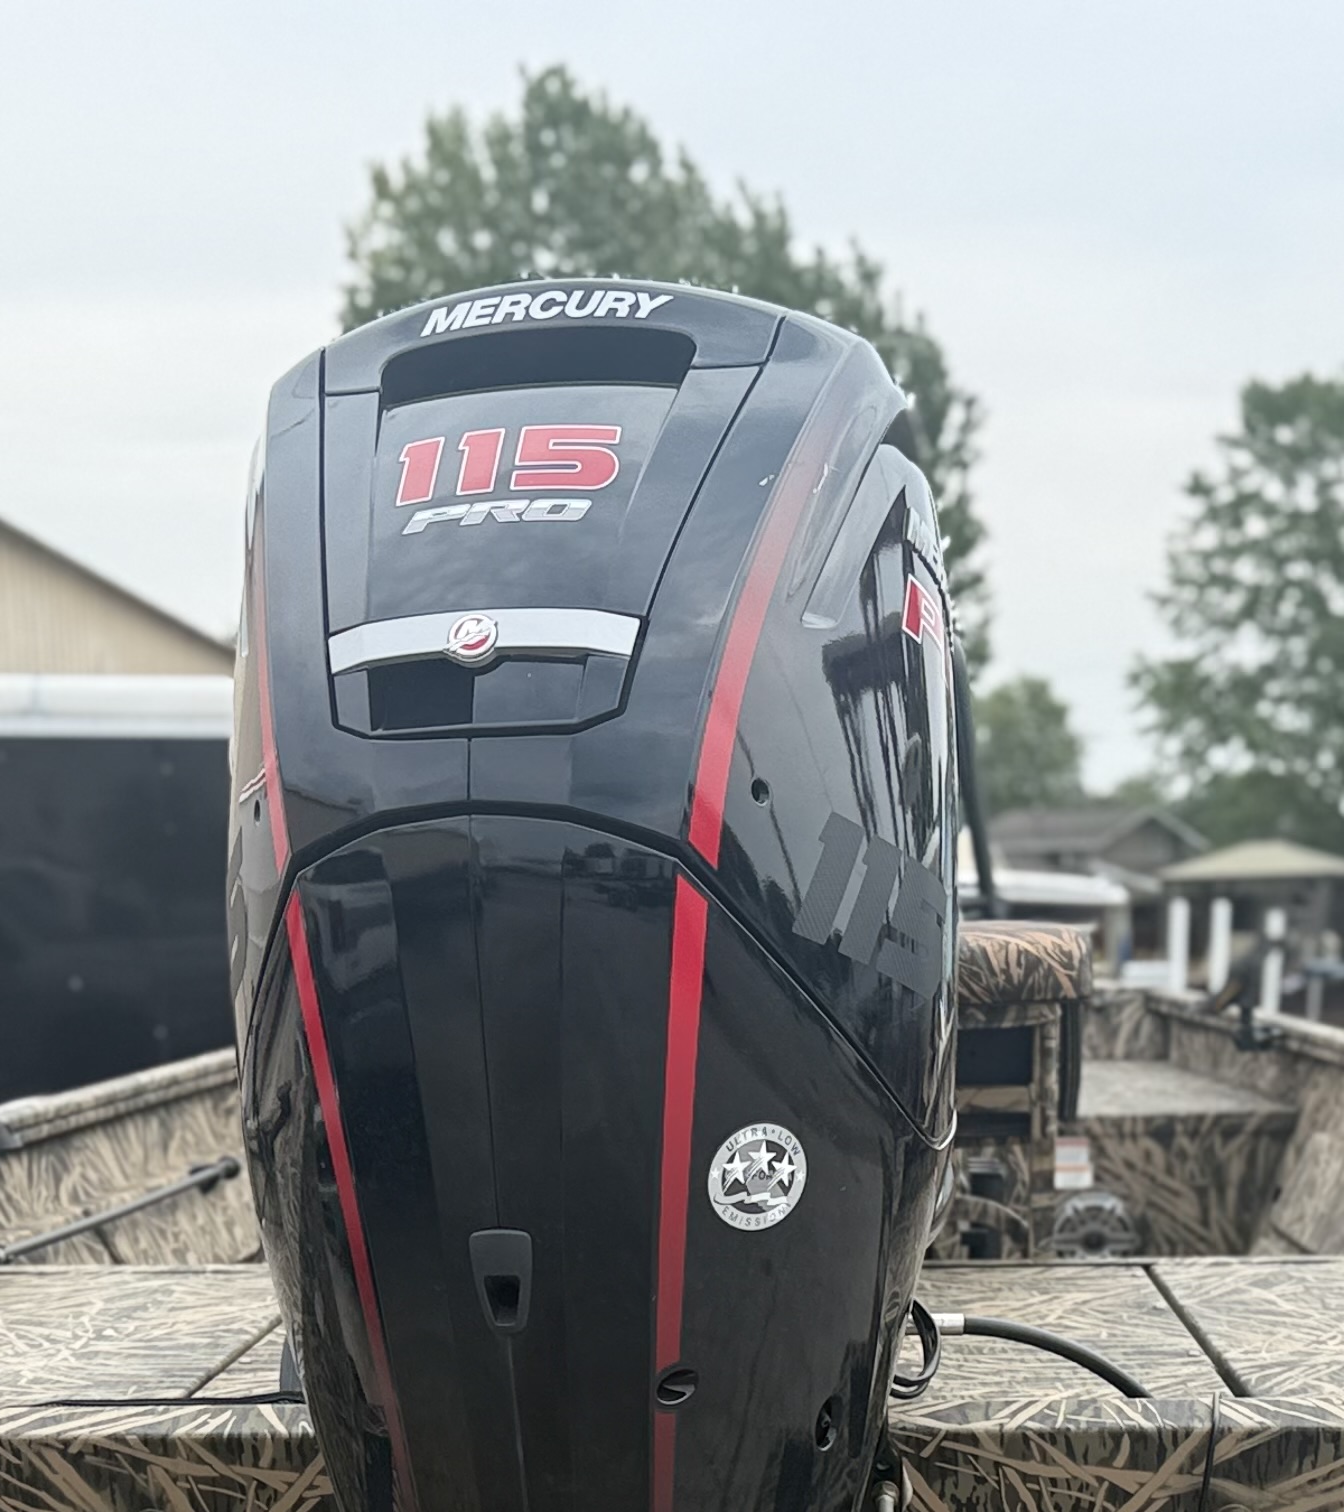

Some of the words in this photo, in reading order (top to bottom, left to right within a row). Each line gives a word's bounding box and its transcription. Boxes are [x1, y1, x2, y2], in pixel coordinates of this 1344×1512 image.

[420, 290, 674, 337] MERCURY
[395, 424, 622, 507] 115
[401, 499, 592, 535] PRO
[726, 1126, 767, 1152] ULTRA
[777, 1130, 801, 1156] LOW
